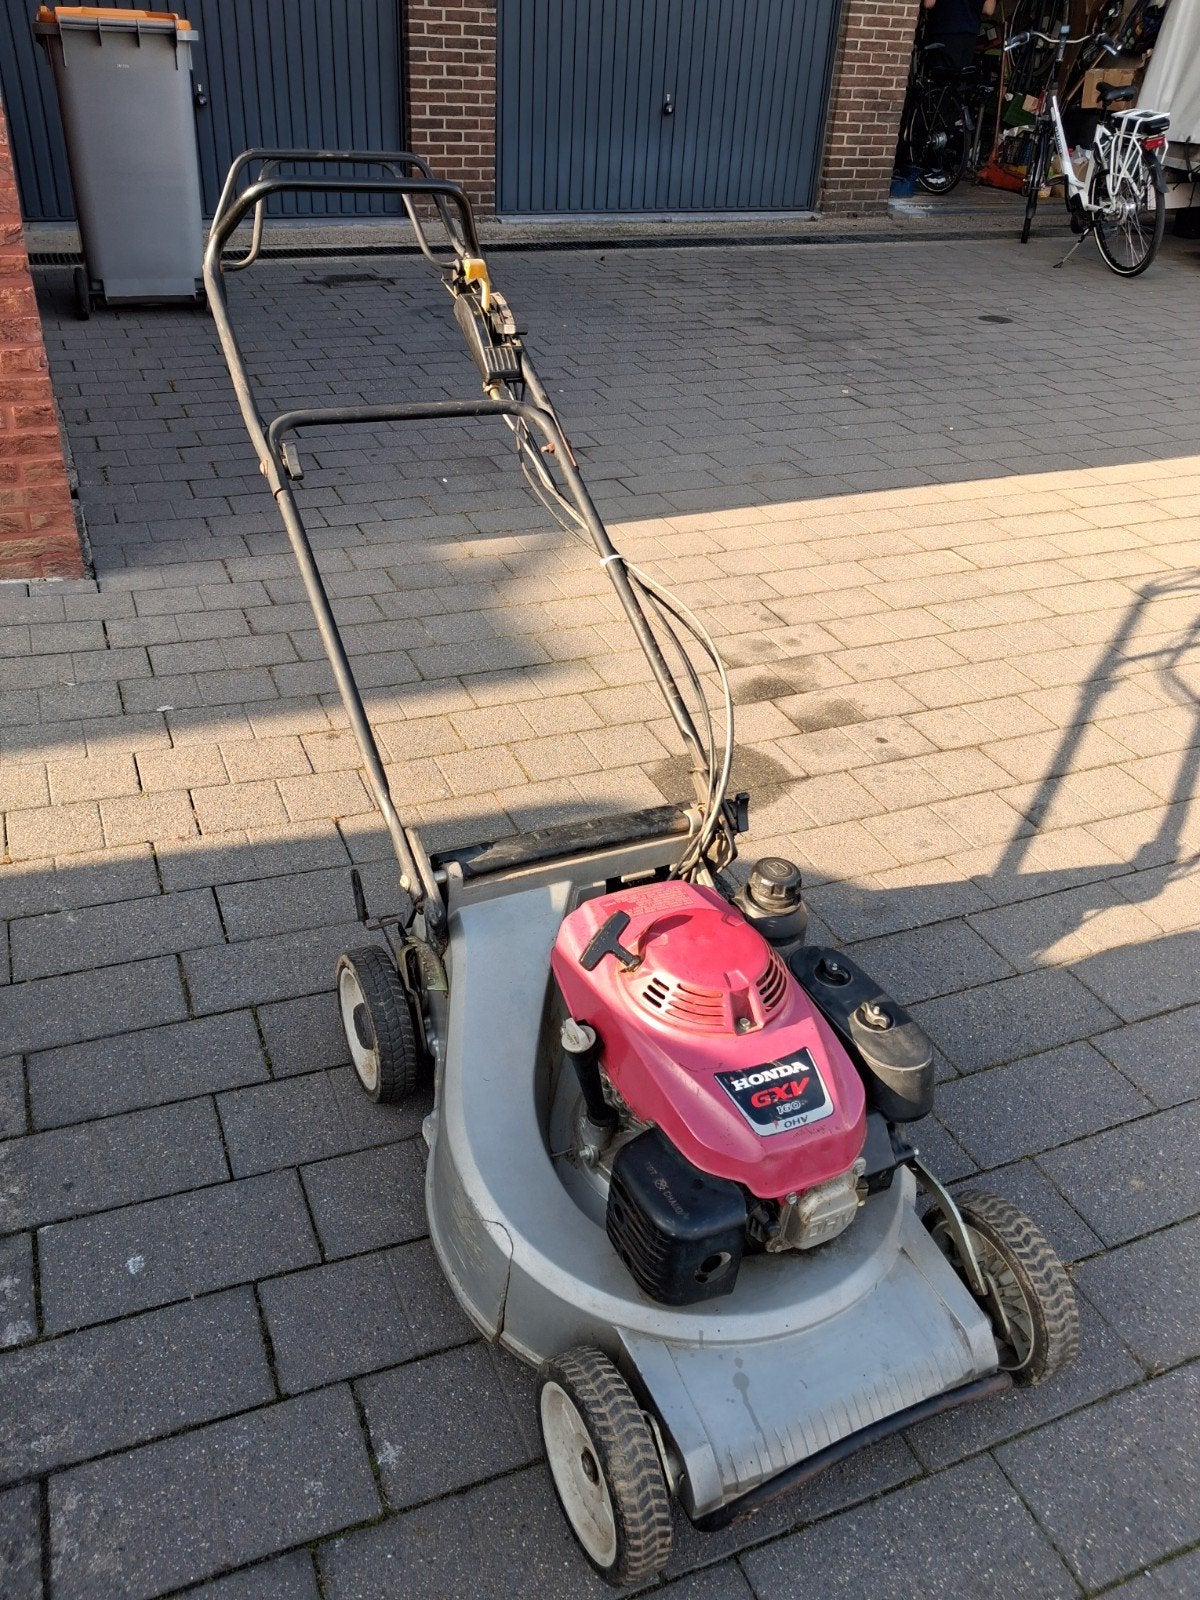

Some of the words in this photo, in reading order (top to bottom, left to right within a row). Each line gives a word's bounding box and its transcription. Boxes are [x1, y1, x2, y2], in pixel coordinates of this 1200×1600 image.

[731, 1061, 810, 1092] HONDA
[750, 1077, 810, 1108] GXV
[776, 1101, 801, 1115] 160
[783, 1115, 809, 1129] OHV
